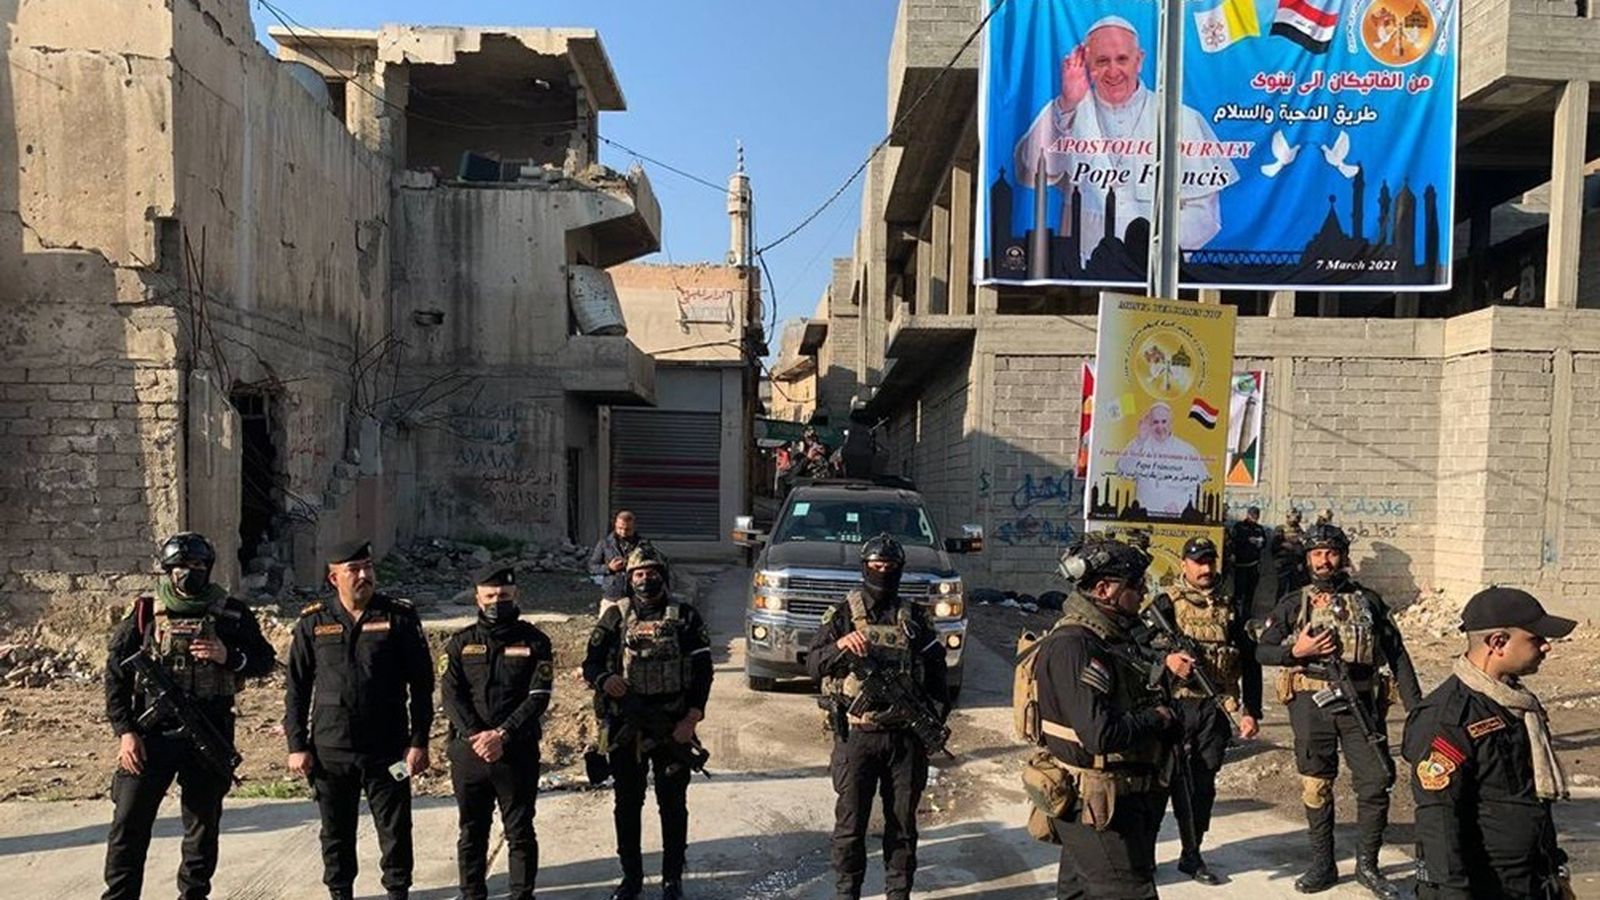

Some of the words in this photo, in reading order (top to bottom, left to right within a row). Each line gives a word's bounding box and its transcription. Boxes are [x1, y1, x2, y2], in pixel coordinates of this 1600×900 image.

[1253, 73, 1293, 92] نينوى
[1299, 72, 1324, 93] الى
[1330, 72, 1402, 93] الفاتيكان
[1408, 77, 1431, 92] من
[1214, 104, 1273, 122] والسلام
[1279, 105, 1328, 124] المحبة
[1334, 107, 1377, 124] طريق
[1051, 140, 1153, 155] APOSTOLIC
[1074, 163, 1130, 188] Pope
[1139, 164, 1229, 186] Fncis
[1316, 260, 1324, 270] 7
[1325, 260, 1365, 270] March
[1368, 260, 1397, 271] 2021
